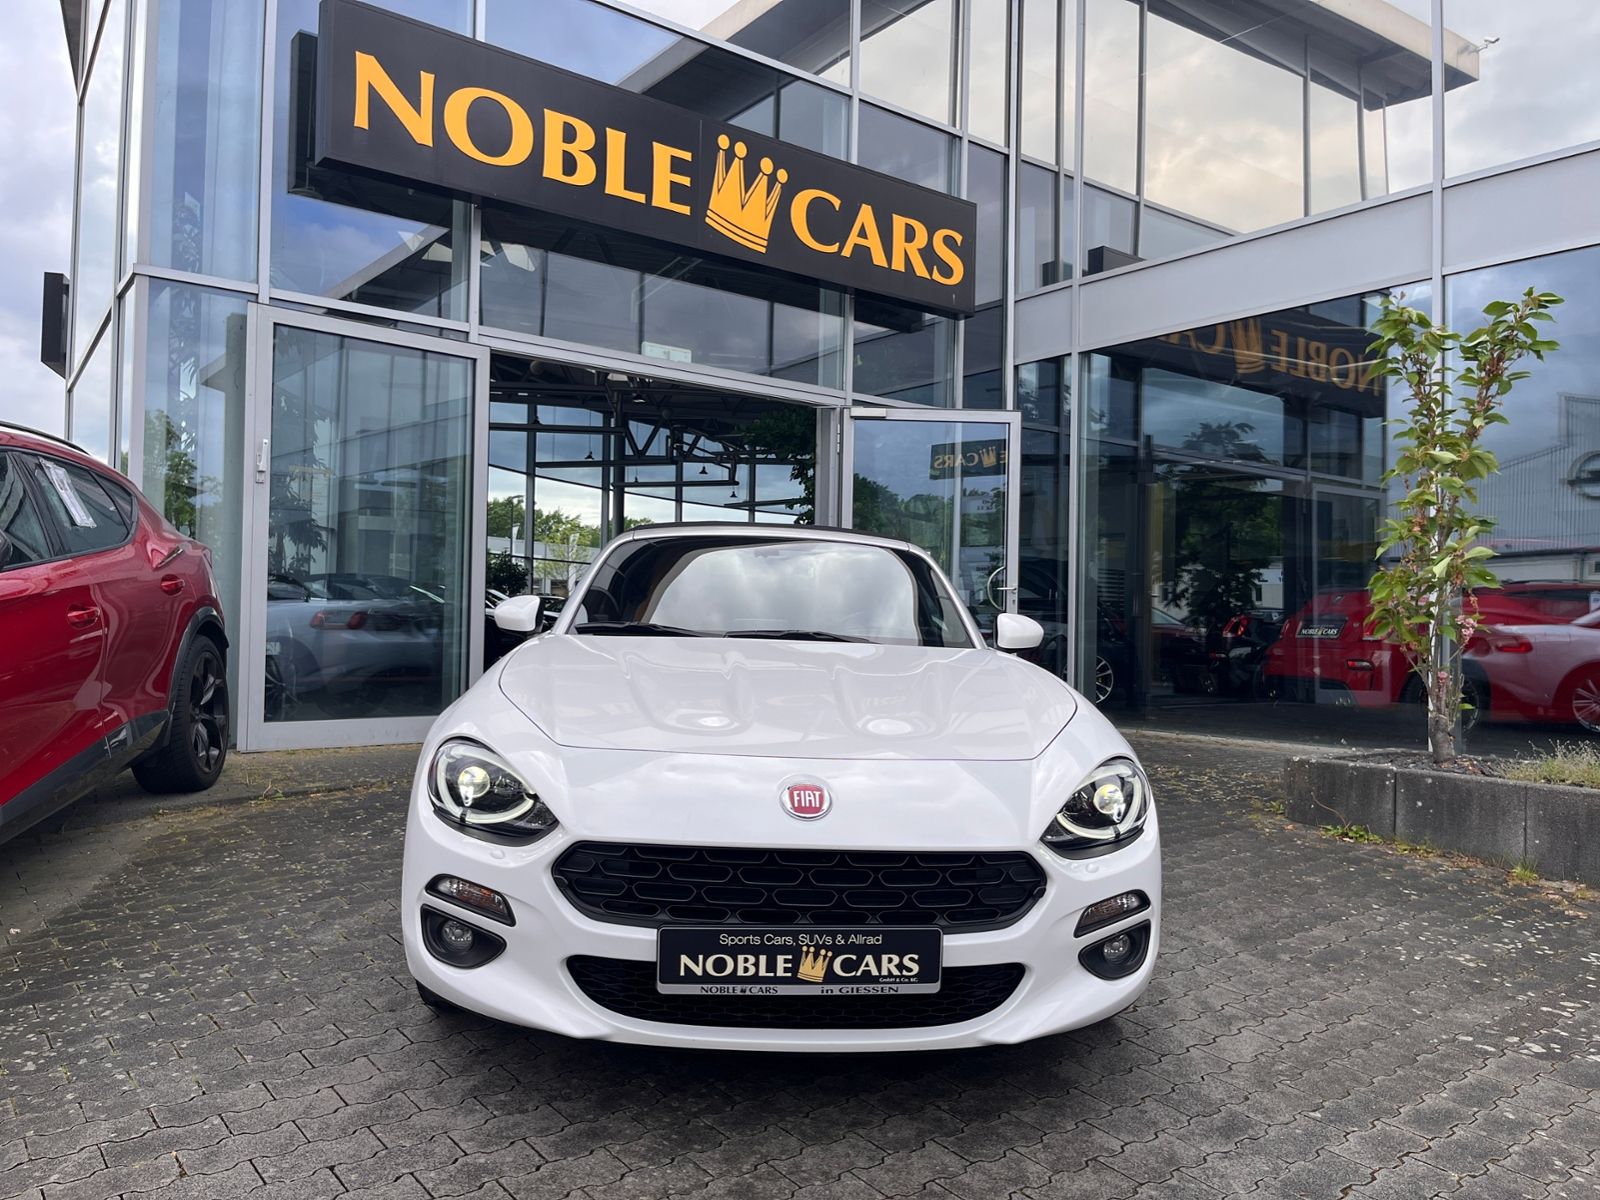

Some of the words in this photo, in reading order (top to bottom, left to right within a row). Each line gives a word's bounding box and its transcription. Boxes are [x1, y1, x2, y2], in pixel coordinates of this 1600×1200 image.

[353, 50, 692, 216] NOBLE
[790, 188, 965, 286] CARS
[793, 790, 821, 808] FIAT
[719, 933, 761, 947] Sports
[763, 933, 796, 947] Cars,
[798, 933, 833, 946] SUVs
[835, 934, 845, 945] &
[847, 934, 883, 945] Allrad
[679, 954, 793, 977] NOBLE
[833, 954, 920, 977] CARS
[700, 986, 738, 994] NOBLE
[749, 986, 778, 994] CARS
[821, 986, 834, 994] in
[838, 986, 899, 994] GIESSEN
